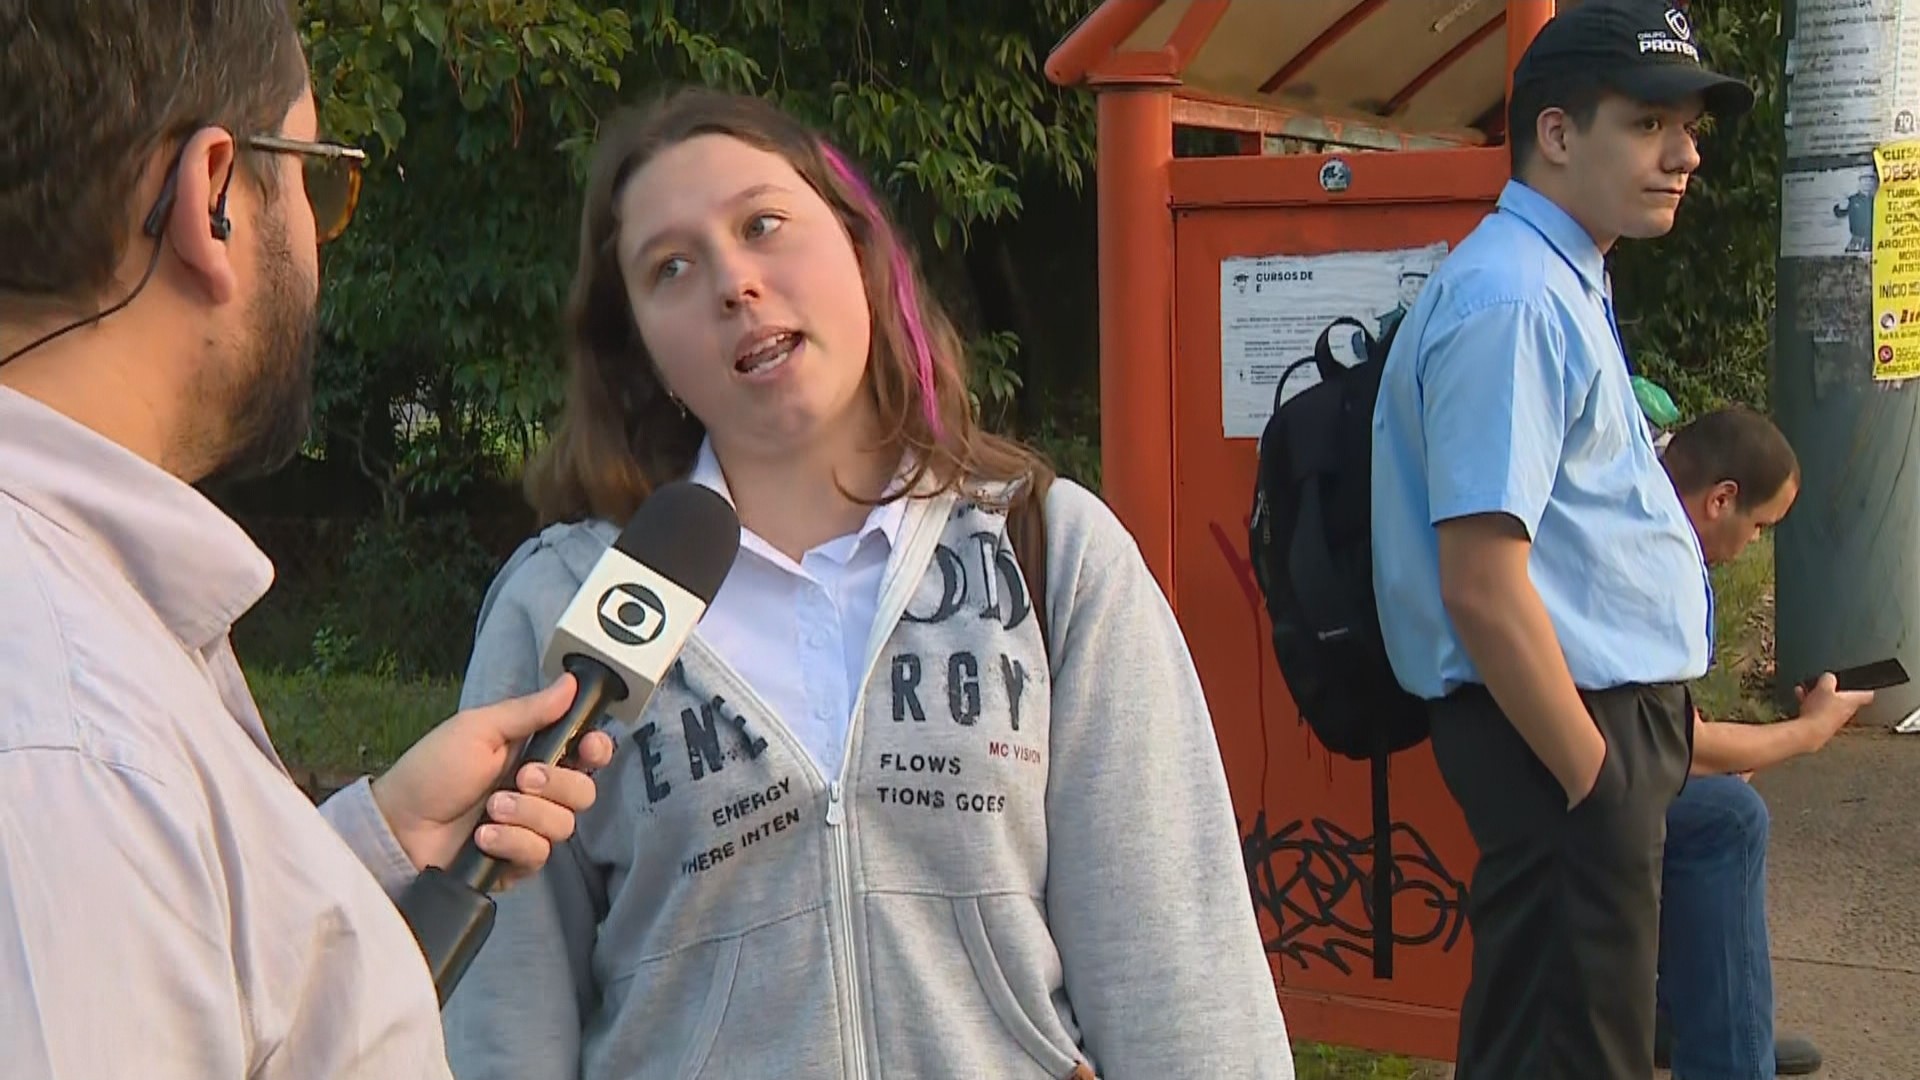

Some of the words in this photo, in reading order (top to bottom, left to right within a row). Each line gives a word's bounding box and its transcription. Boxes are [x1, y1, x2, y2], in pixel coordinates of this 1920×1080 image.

[1256, 271, 1298, 282] CURSOS
[1300, 271, 1313, 280] DE
[989, 741, 1009, 757] MC
[712, 777, 790, 827] ENERGY
[880, 753, 962, 775] FLOWS
[741, 807, 800, 848] INTEN
[876, 787, 945, 808] TIONS
[955, 793, 1006, 812] GOES
